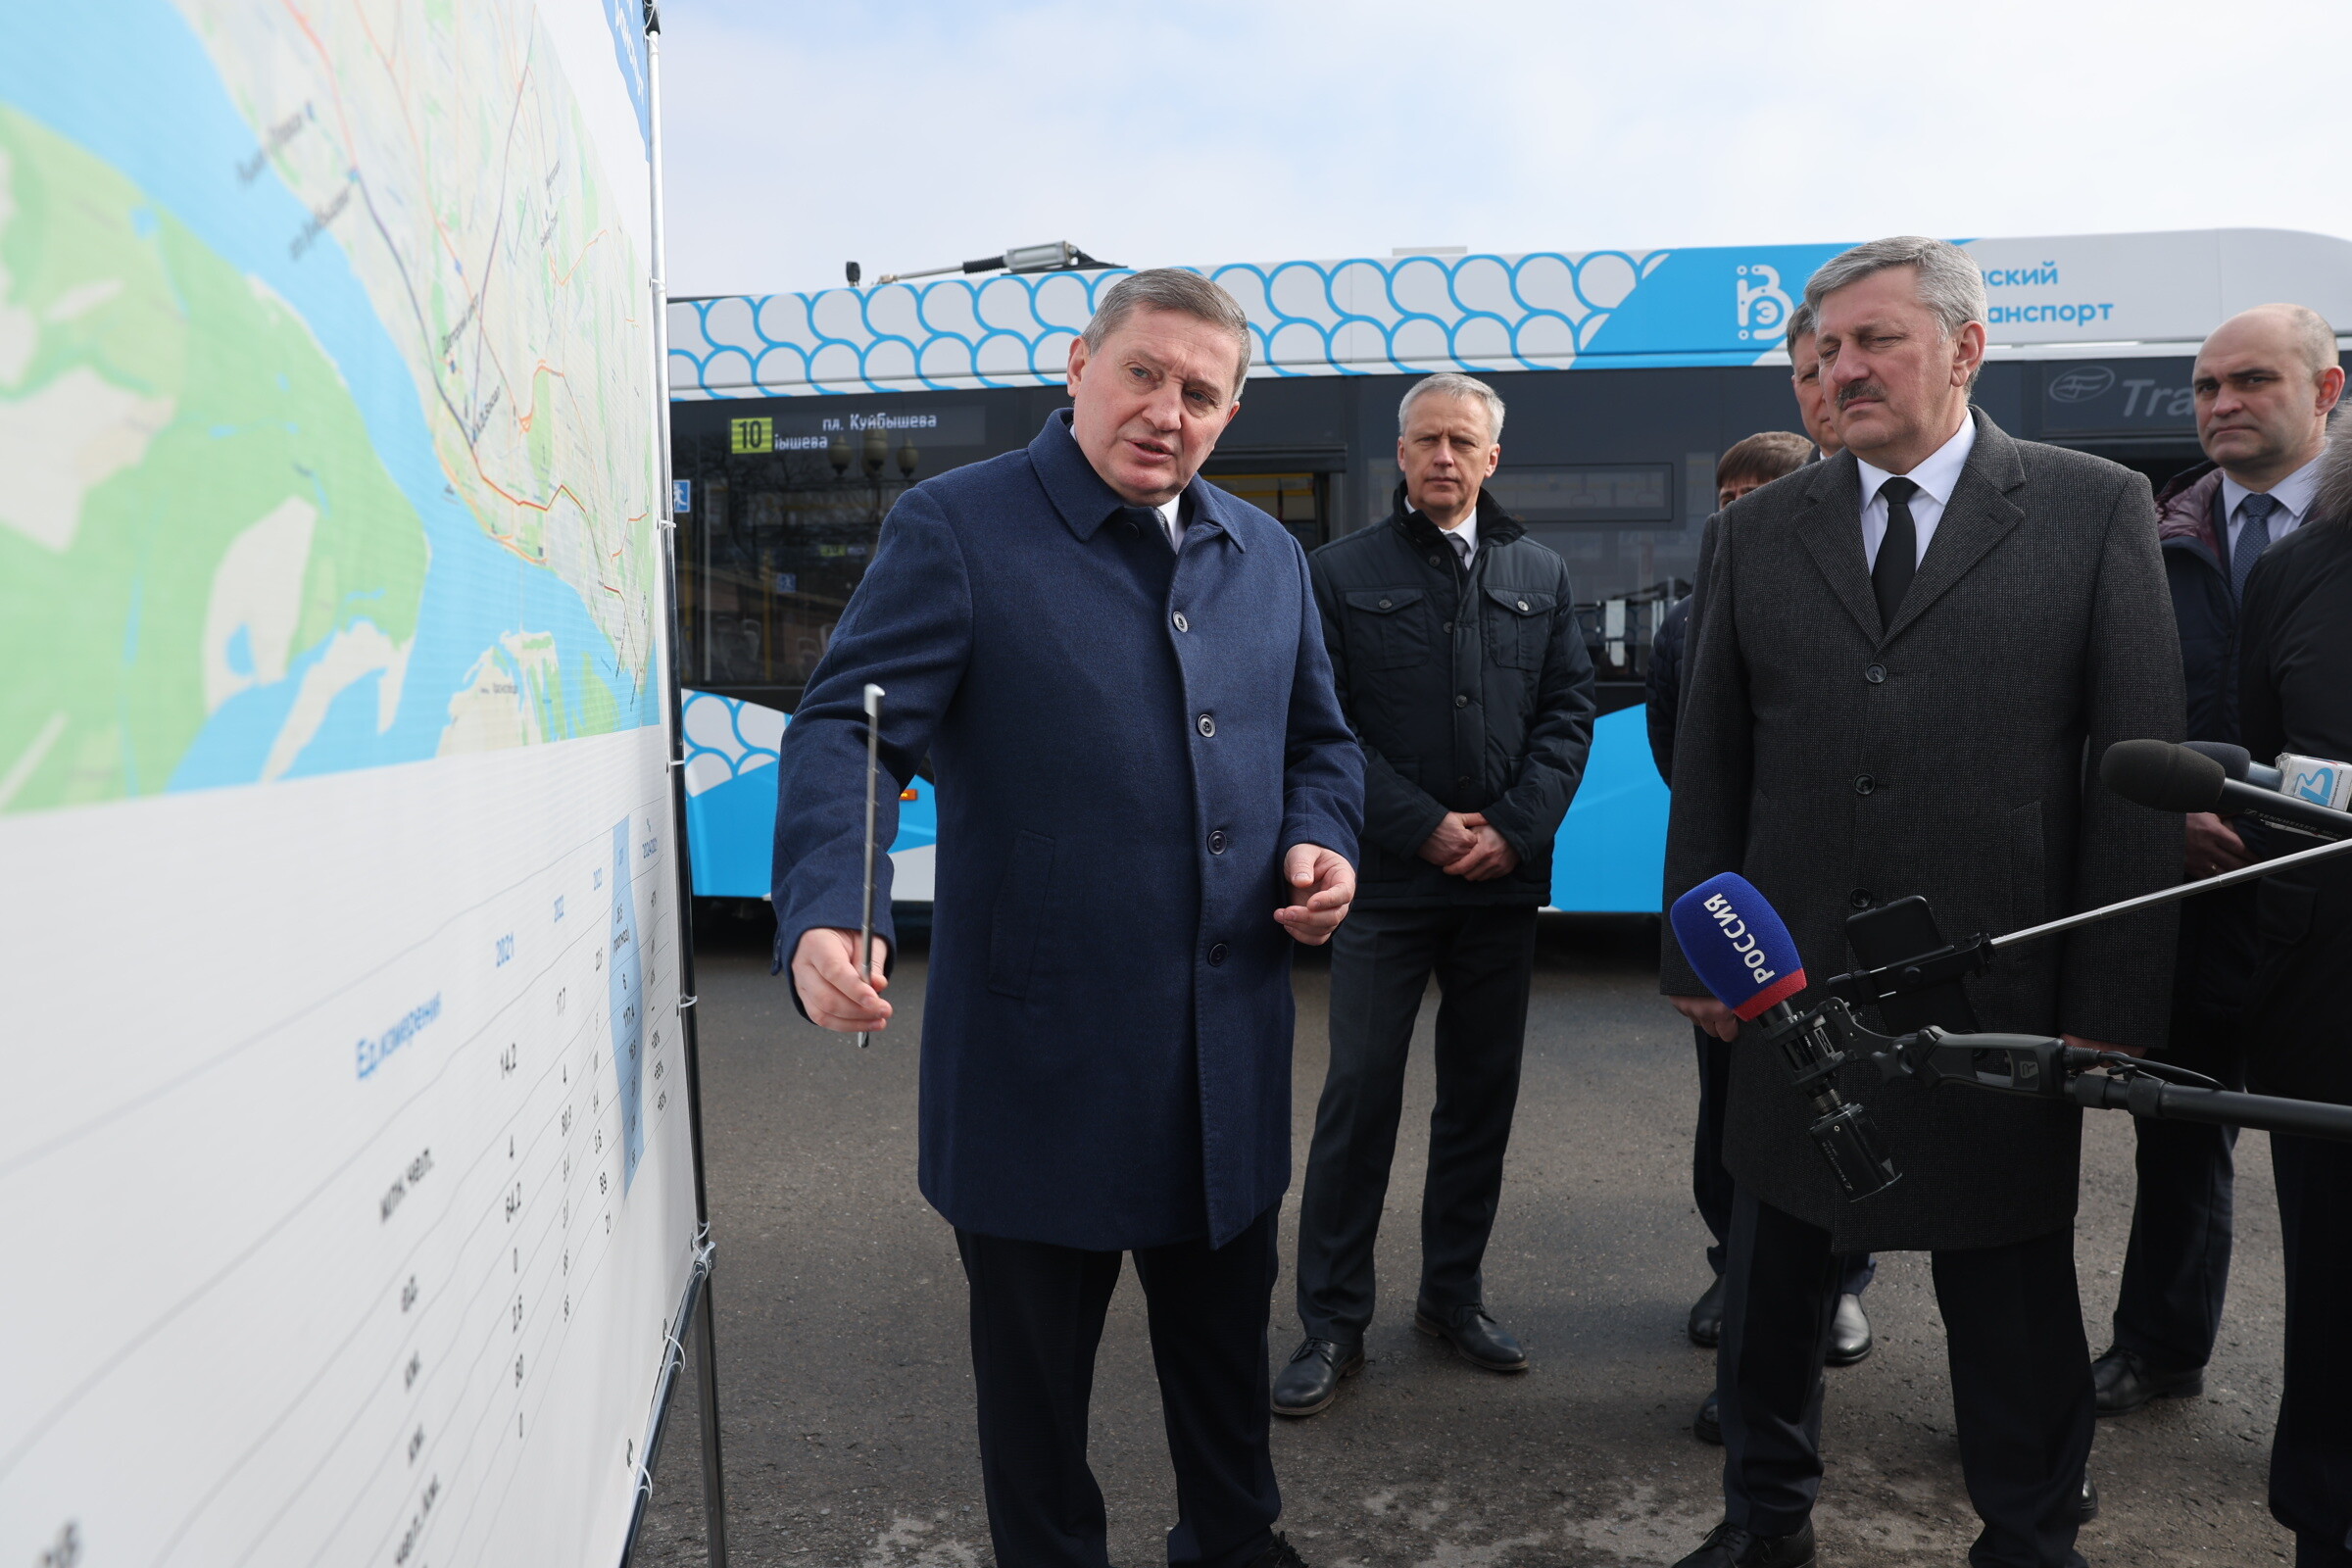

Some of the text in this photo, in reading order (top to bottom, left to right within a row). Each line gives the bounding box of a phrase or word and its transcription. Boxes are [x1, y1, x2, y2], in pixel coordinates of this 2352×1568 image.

[1981, 260, 2058, 287] ский
[2122, 378, 2195, 417] Tra
[739, 420, 761, 449] 10
[823, 413, 937, 431] пл. Куйбышева
[1703, 893, 1775, 984] РОССИЯ
